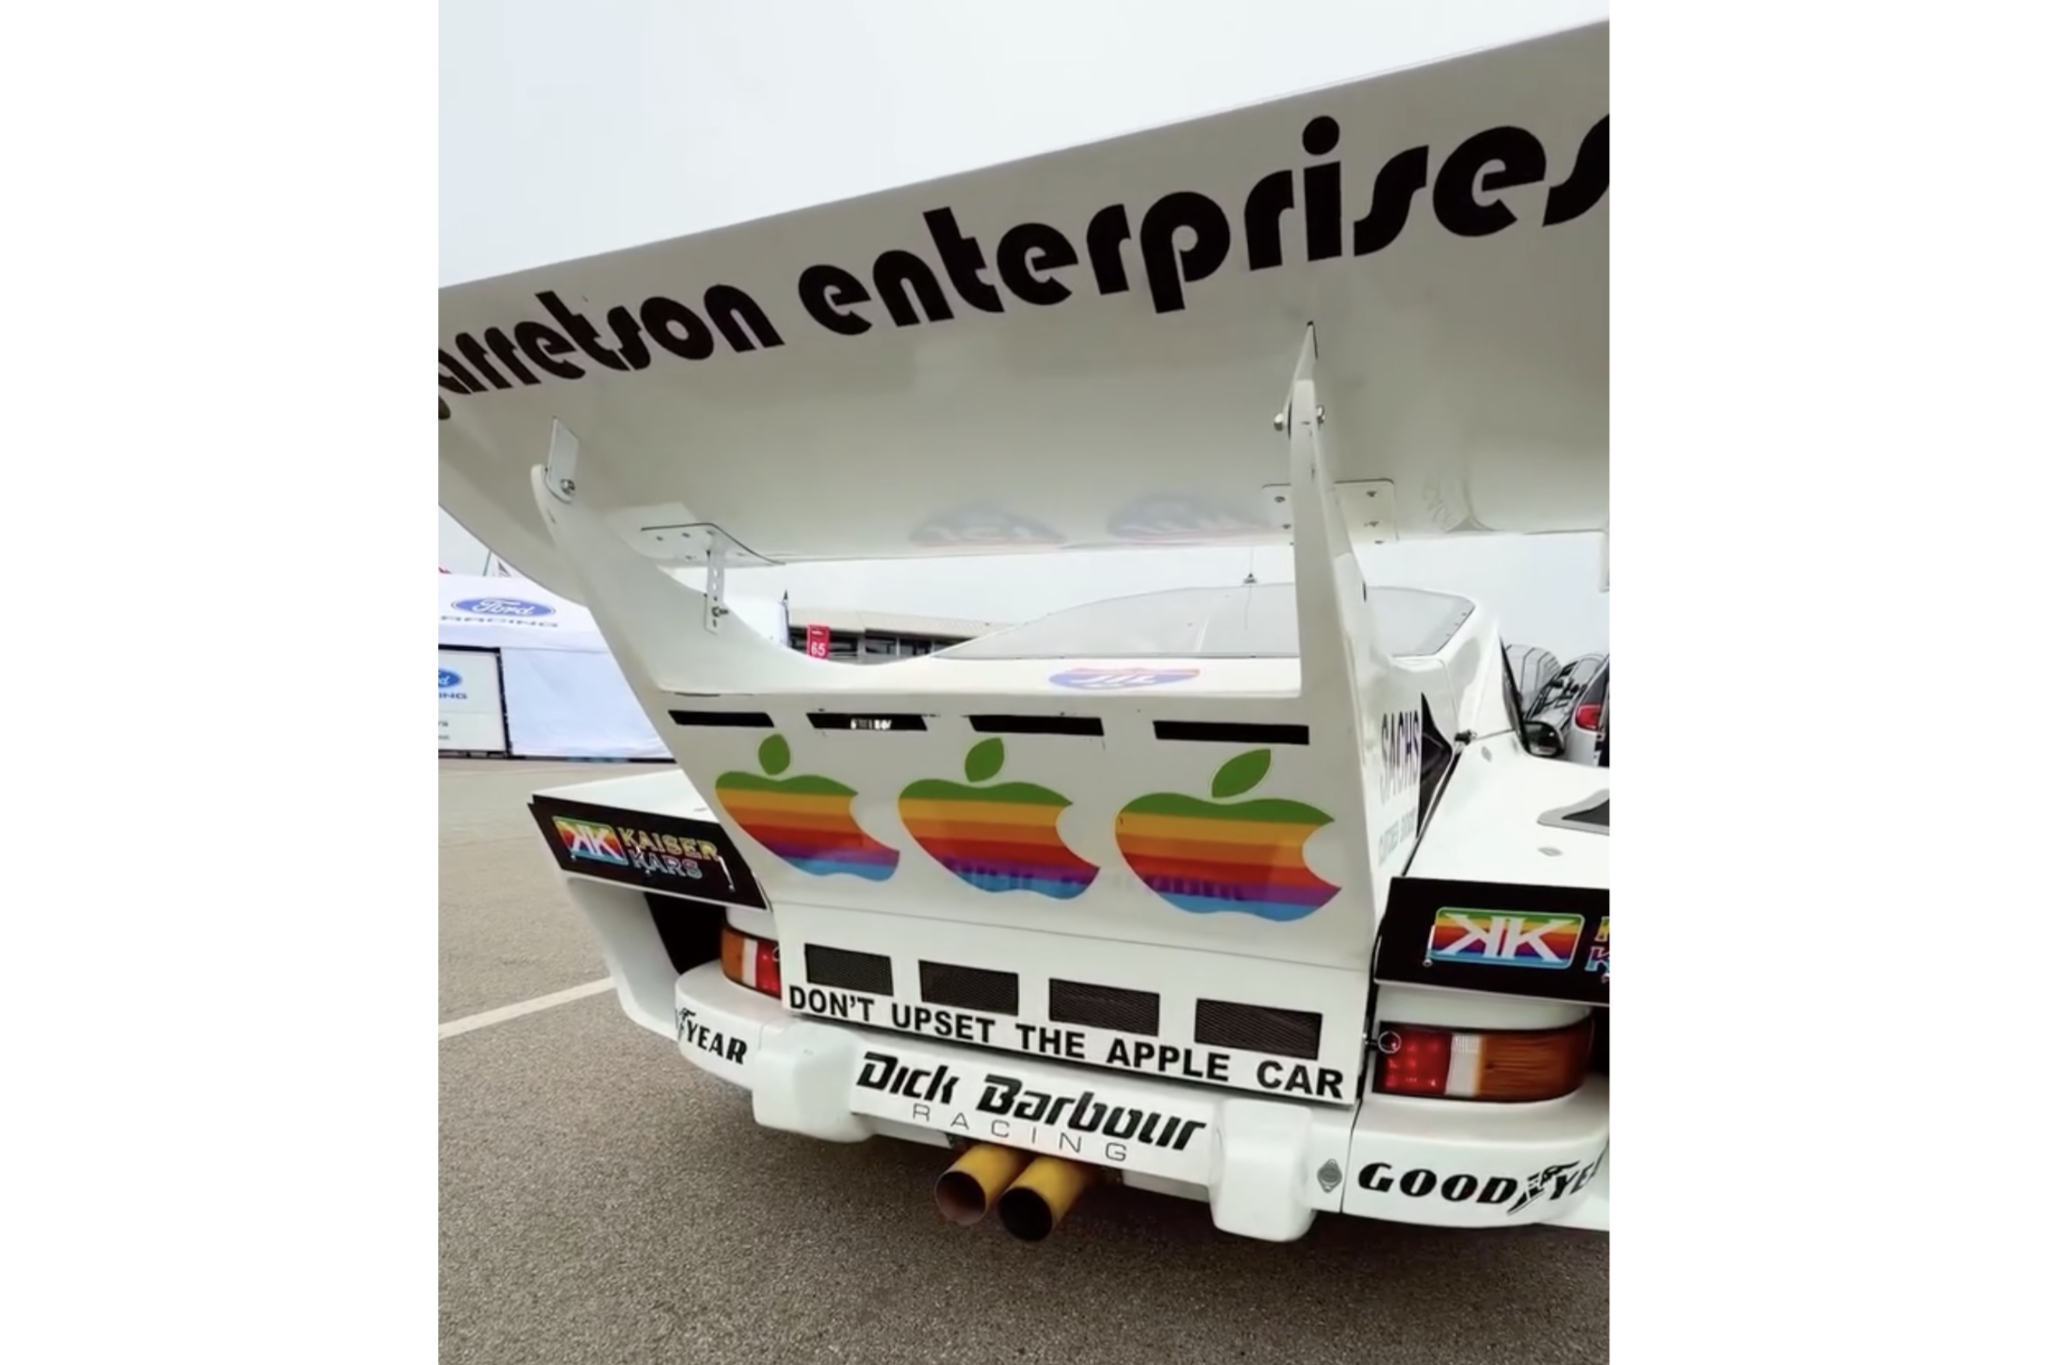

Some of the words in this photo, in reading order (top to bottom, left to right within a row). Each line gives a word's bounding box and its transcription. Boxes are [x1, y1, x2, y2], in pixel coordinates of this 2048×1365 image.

[811, 641, 826, 657] 65
[1380, 709, 1420, 805] SACHS
[618, 826, 719, 861] KAISER
[629, 849, 703, 880] KARS
[789, 985, 875, 1022] DON'T
[891, 1003, 996, 1043] UPSET
[1015, 1023, 1086, 1059] THE
[1106, 1038, 1231, 1083] APPLE
[1256, 1060, 1344, 1099] CAR
[856, 1051, 960, 1104] Dick
[976, 1072, 1207, 1151] Barbour
[912, 1102, 1127, 1162] RACING
